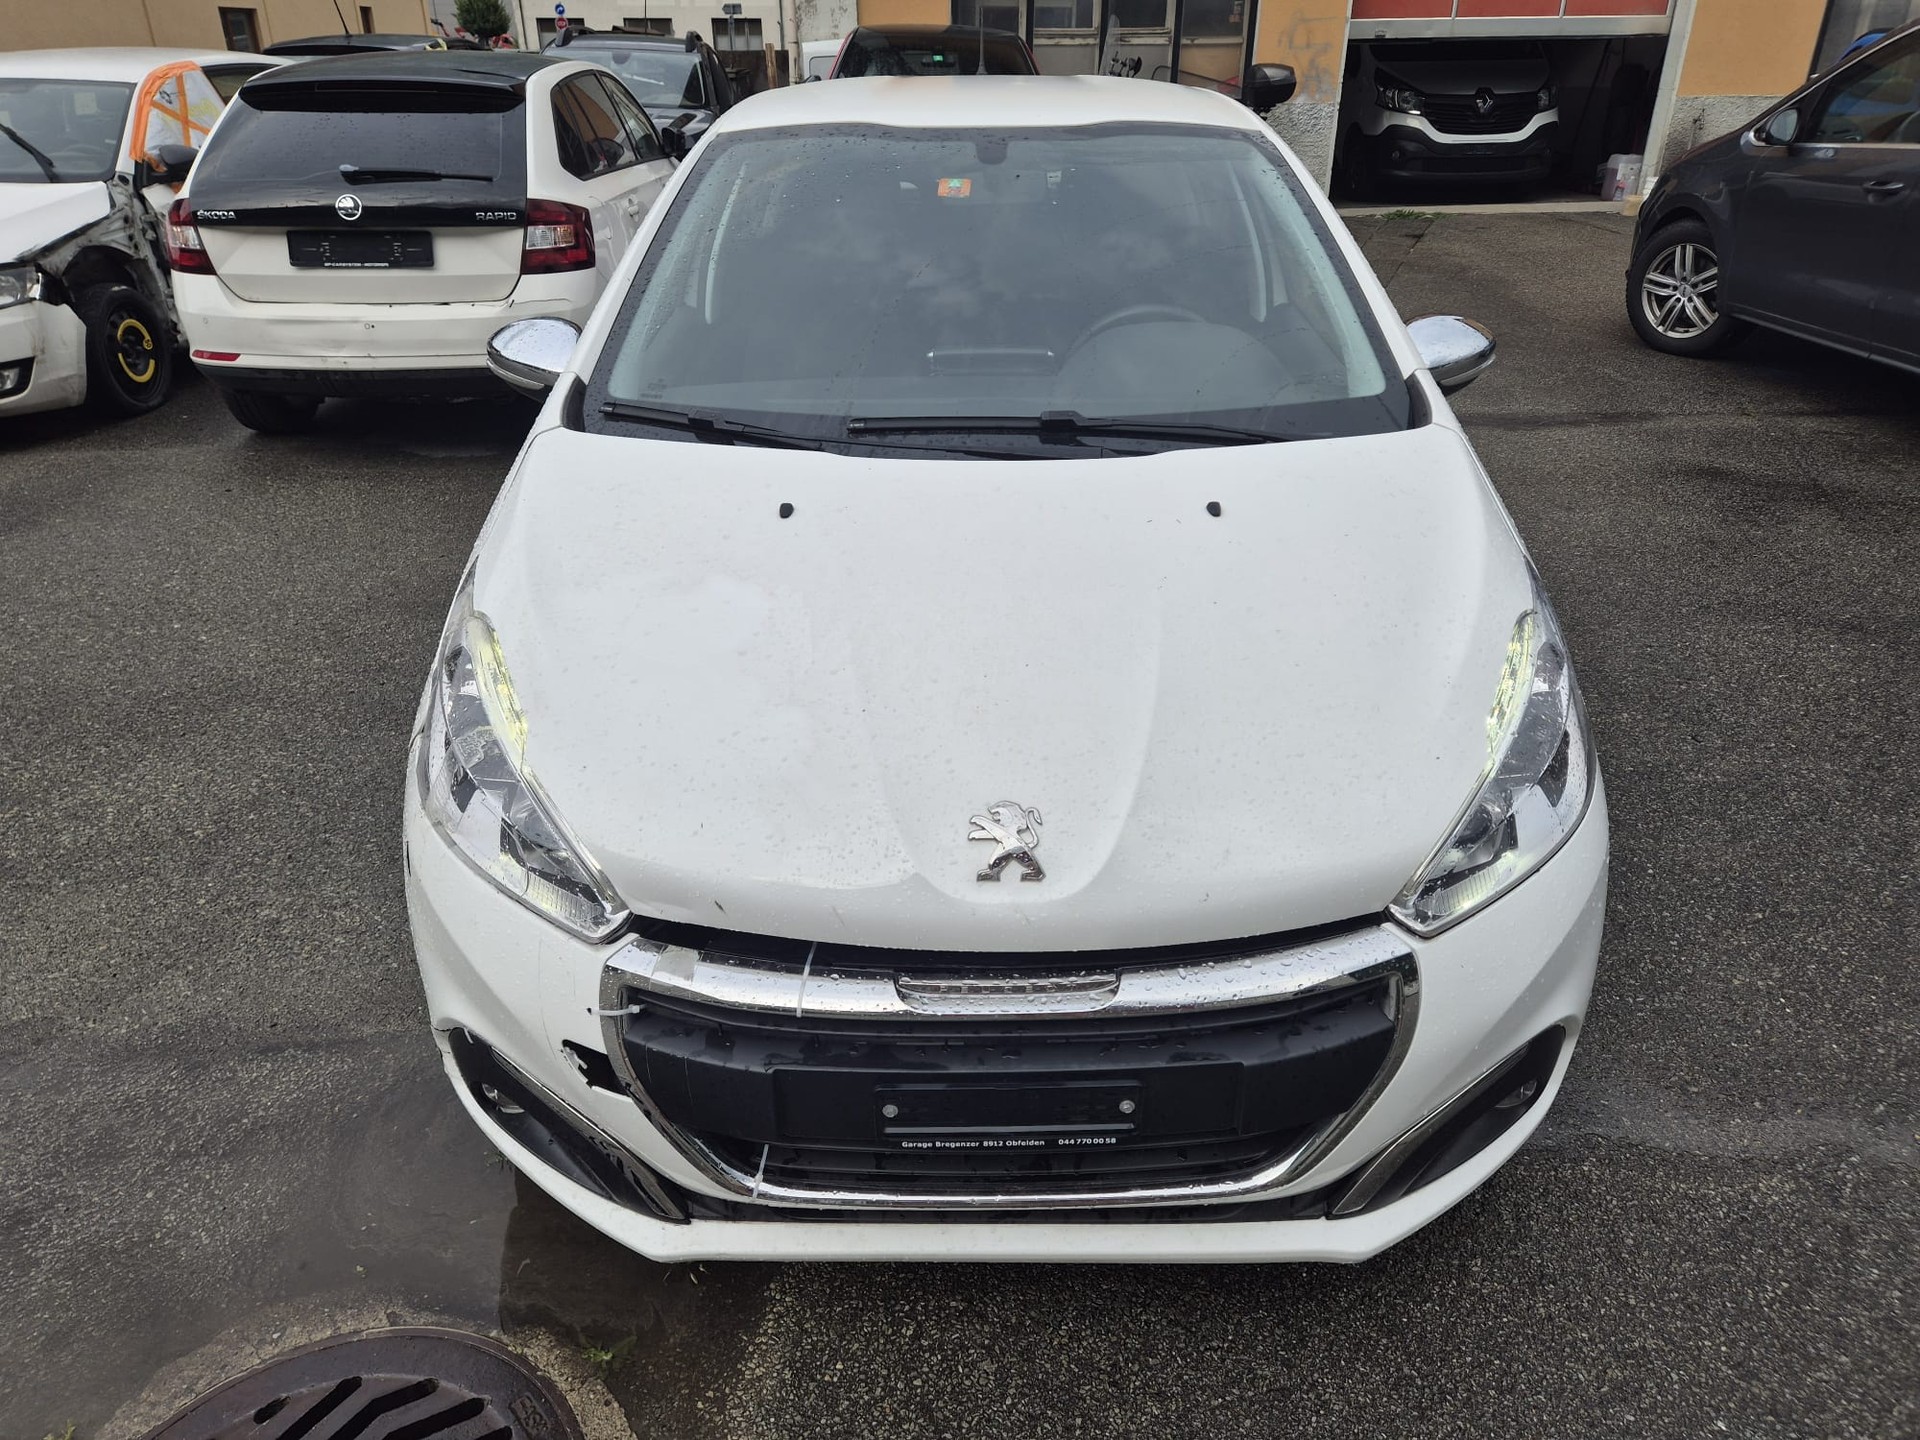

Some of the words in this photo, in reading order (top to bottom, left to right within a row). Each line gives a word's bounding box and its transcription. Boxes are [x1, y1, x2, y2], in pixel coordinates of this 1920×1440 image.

[476, 212, 517, 221] RAPID
[901, 1140, 933, 1149] Garage
[935, 1140, 980, 1149] Bregenzer
[1005, 1139, 1045, 1147] Obfelden
